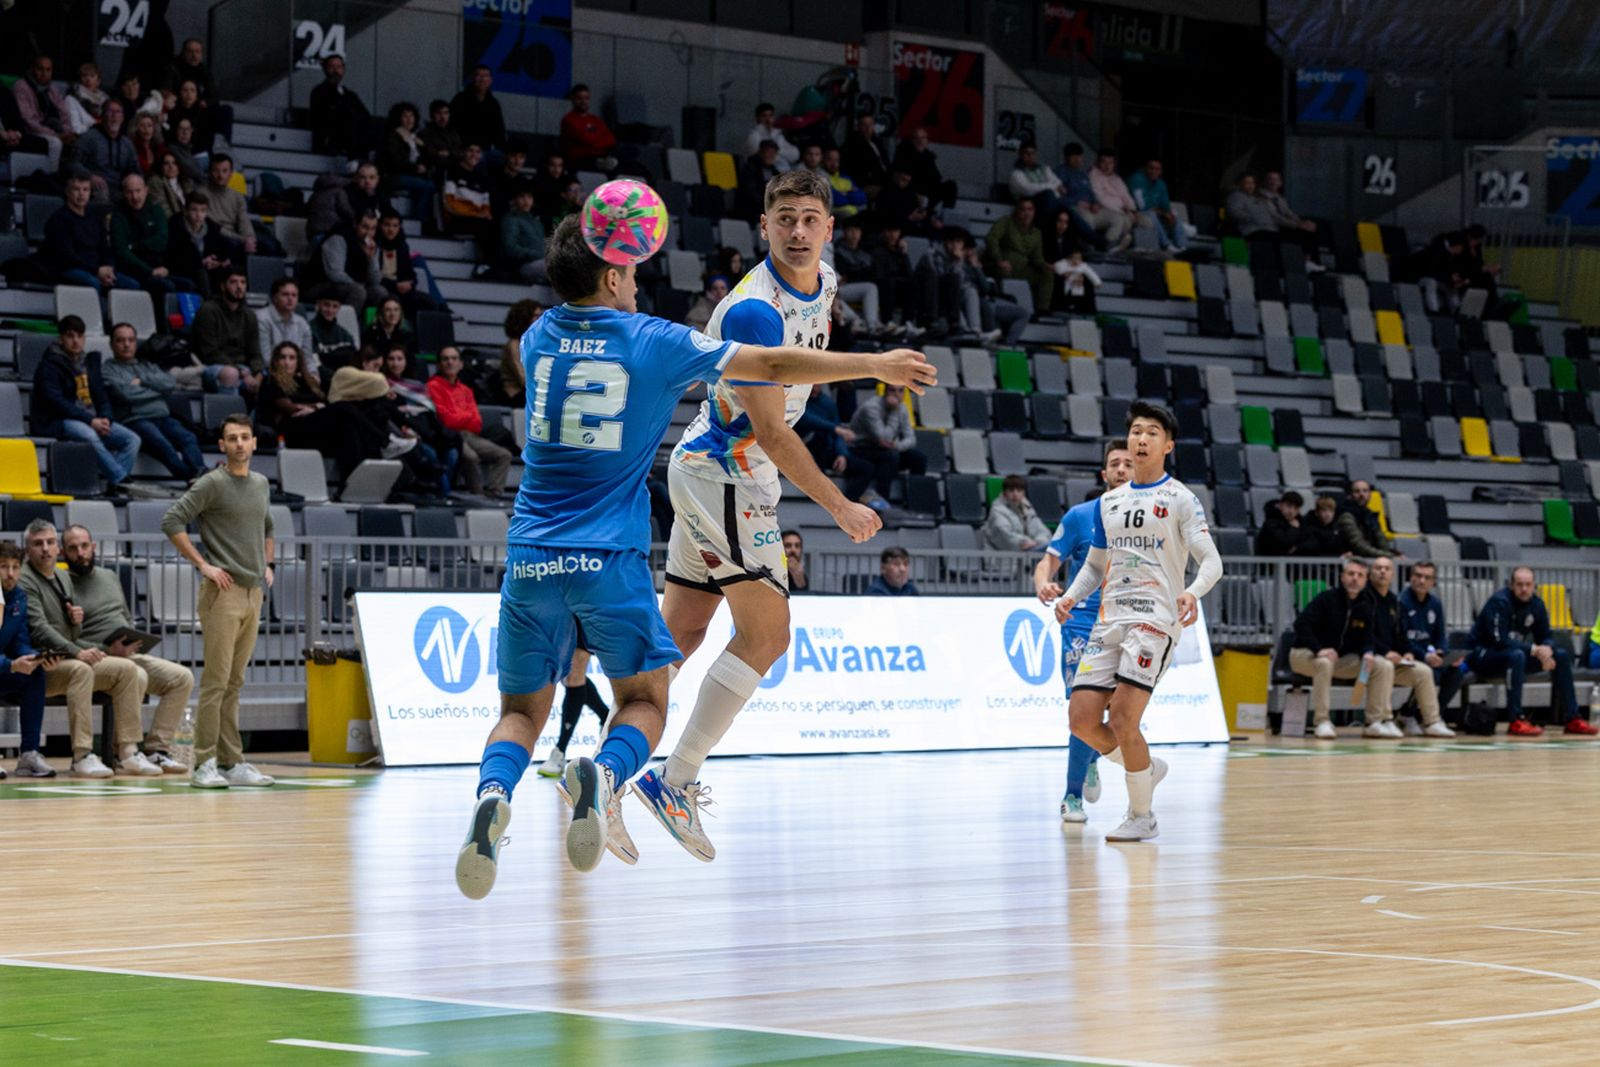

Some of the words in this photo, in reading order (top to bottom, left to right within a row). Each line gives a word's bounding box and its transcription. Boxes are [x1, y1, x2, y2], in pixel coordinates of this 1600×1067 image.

[101, 0, 150, 46] 24
[295, 20, 346, 68] 24
[893, 43, 956, 73] Sector
[899, 51, 983, 147] 26
[999, 111, 1036, 147] 25
[1546, 137, 1600, 160] Sect
[1364, 154, 1396, 196] 26
[1479, 170, 1530, 208] 26
[558, 338, 607, 354] BAEZ
[530, 355, 630, 452] 12
[1123, 508, 1146, 529] 16
[812, 627, 844, 640] GRUPO
[793, 627, 927, 673] Avanza
[388, 705, 416, 720] Los
[418, 703, 469, 719] sueños
[472, 706, 490, 718] no
[744, 698, 780, 712] ueños
[782, 701, 797, 711] no
[801, 700, 814, 711] se
[817, 699, 879, 714] persiguen,
[881, 699, 895, 711] se
[897, 697, 962, 712] construyen
[986, 696, 1007, 708] Los
[1010, 694, 1048, 708] sueños
[799, 726, 891, 739] www.avanzasi.es
